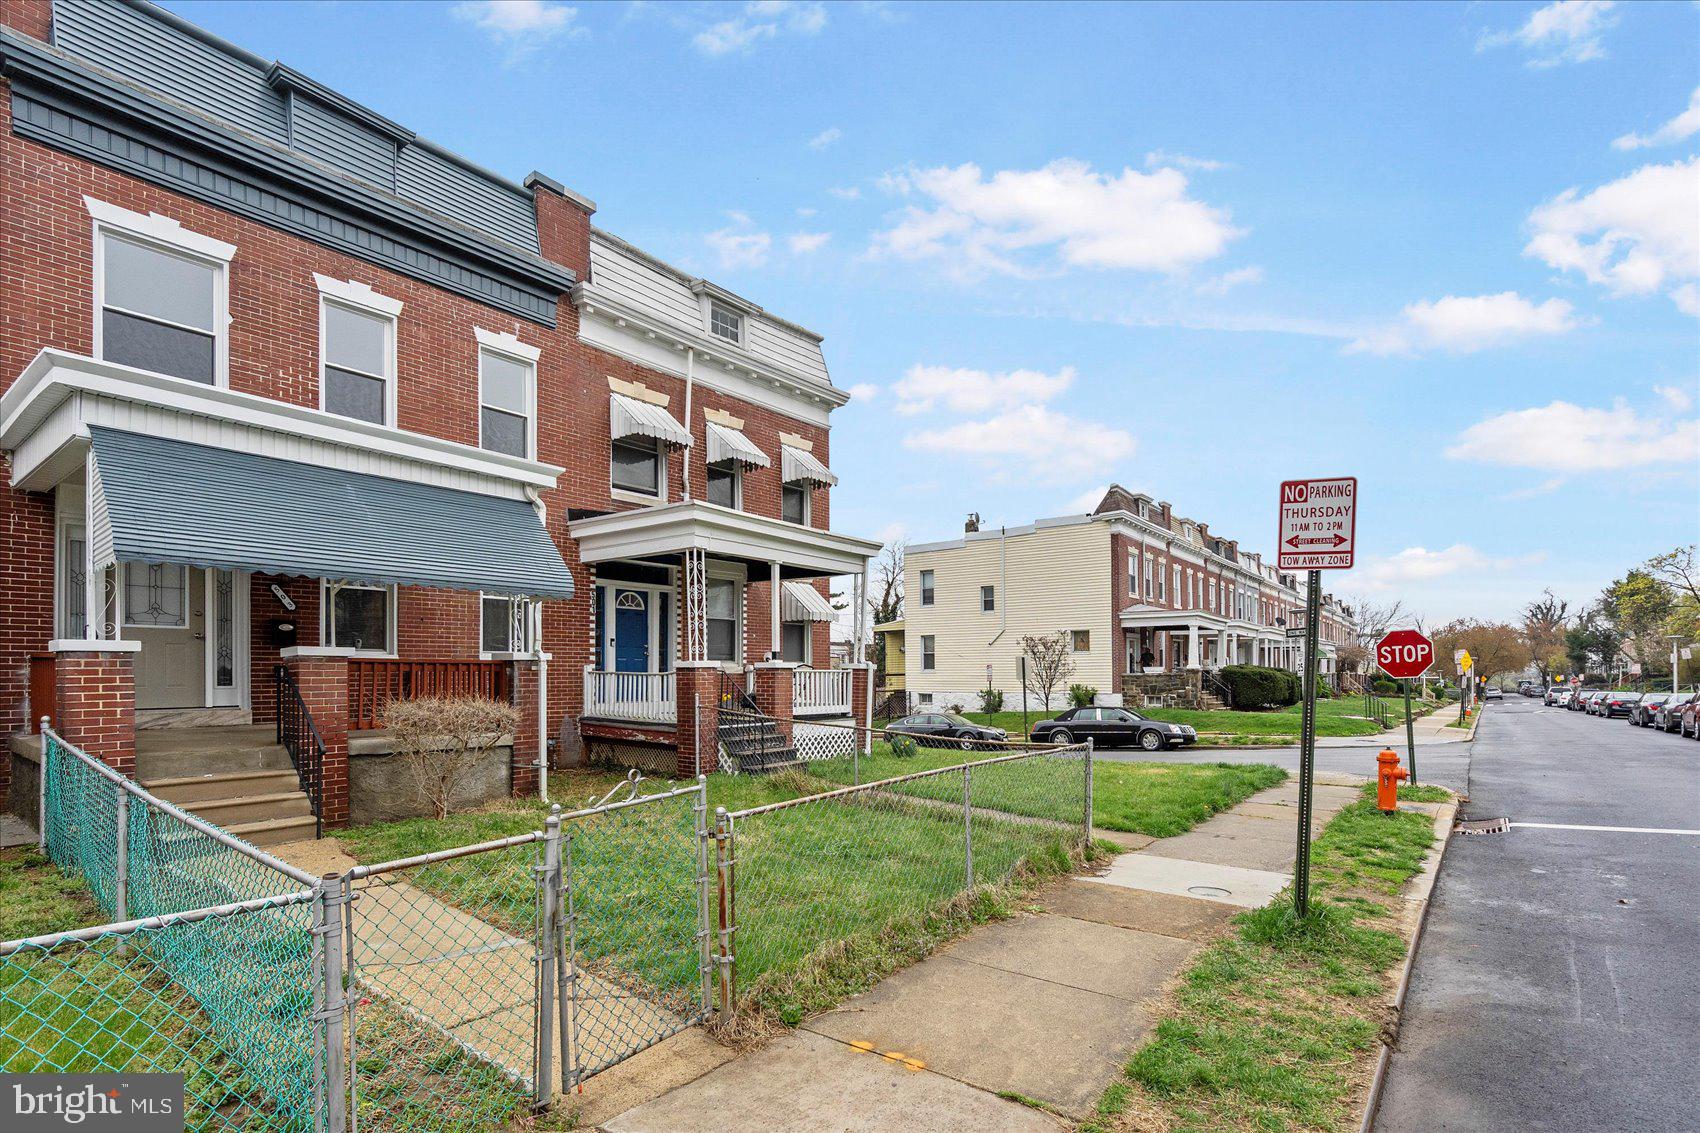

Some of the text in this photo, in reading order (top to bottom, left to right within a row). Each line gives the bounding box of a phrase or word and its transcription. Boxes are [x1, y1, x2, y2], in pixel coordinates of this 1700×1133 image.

[1284, 484, 1352, 502] NO PARKING
[1284, 505, 1351, 519] THURSDAY
[1313, 522, 1324, 531] TO
[1282, 555, 1349, 565] TOW AWAY ZONE
[1380, 644, 1429, 664] STOP
